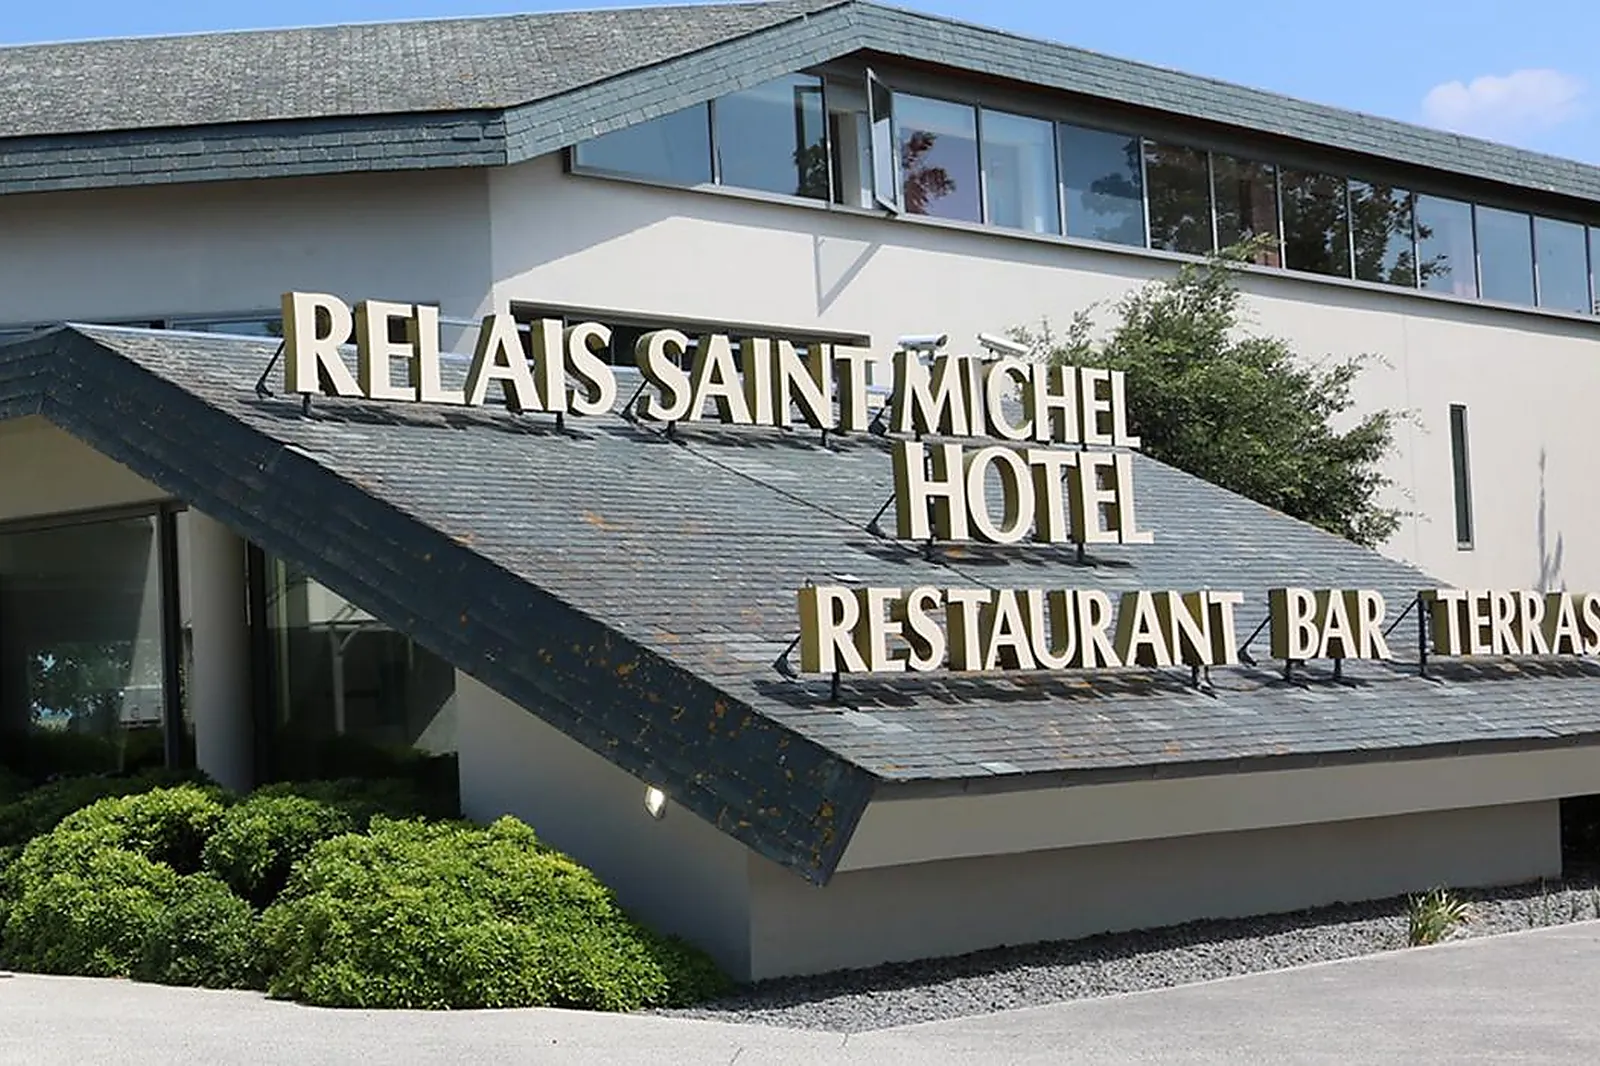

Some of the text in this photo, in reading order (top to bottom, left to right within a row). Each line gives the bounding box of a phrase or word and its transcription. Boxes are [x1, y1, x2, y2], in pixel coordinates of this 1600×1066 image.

[287, 290, 617, 416] RELAIS
[901, 440, 1155, 545] HOTEL
[810, 584, 1600, 674] RESTAURANT BAR TERRAS
